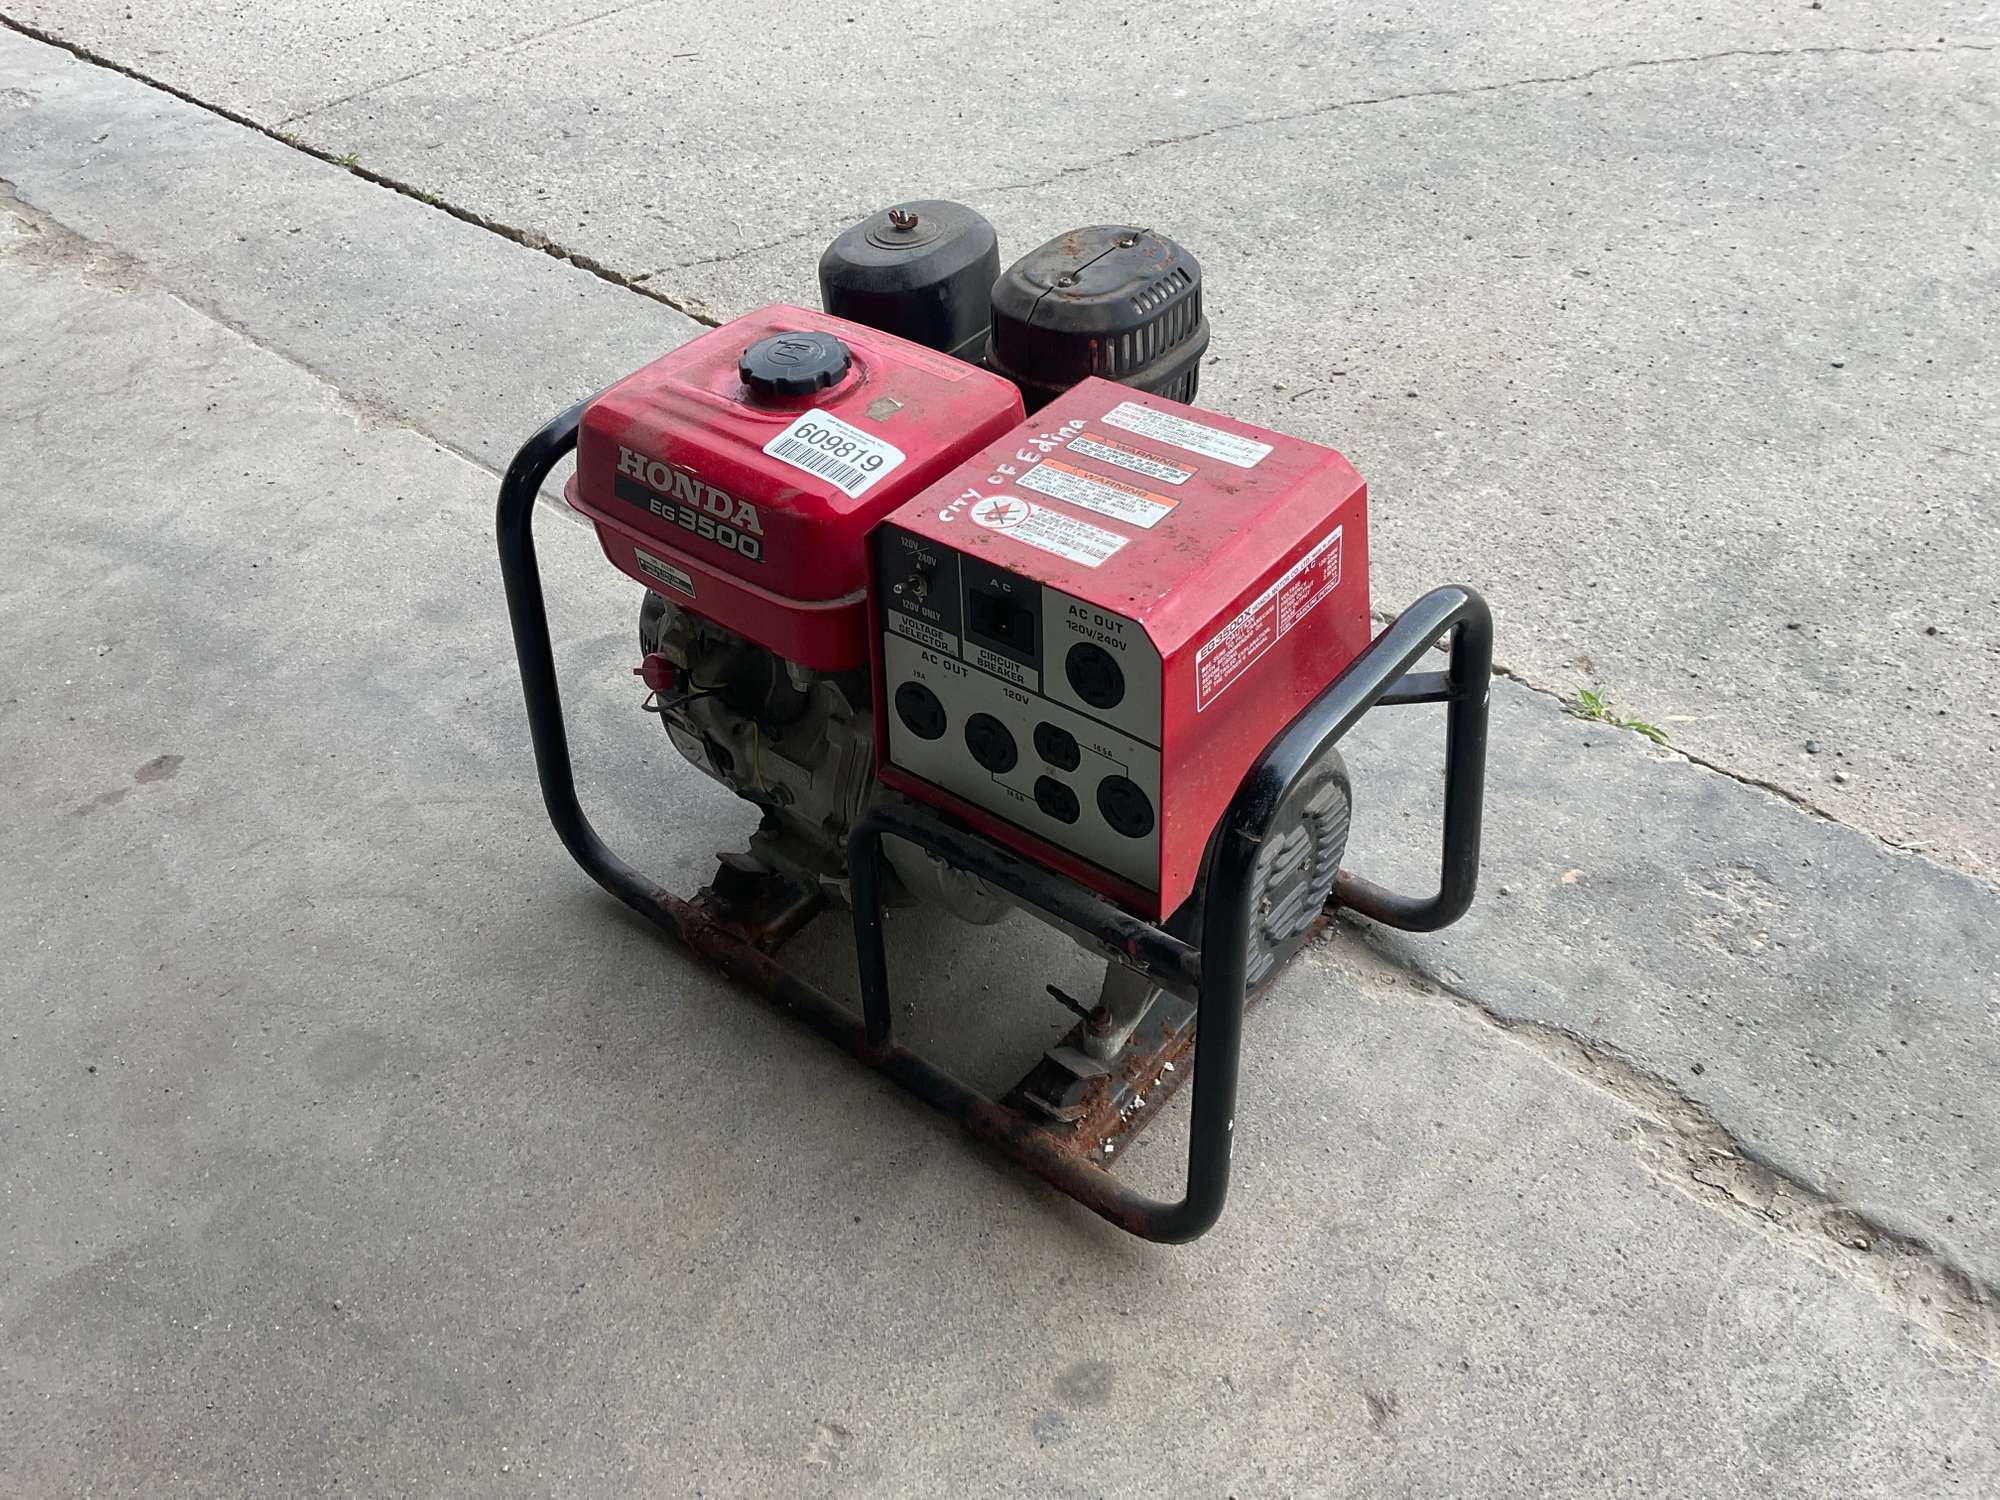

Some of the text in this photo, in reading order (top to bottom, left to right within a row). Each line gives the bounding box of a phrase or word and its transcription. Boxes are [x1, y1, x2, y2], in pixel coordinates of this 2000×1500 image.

[794, 422, 884, 472] 609819
[1116, 443, 1181, 468] WARNING
[617, 446, 764, 536] HONDA
[1083, 472, 1150, 497] WARNING
[900, 536, 919, 550] 120V
[917, 552, 937, 567] 240V
[902, 598, 941, 622] 120V ONLY
[1069, 605, 1124, 633] AC OUT
[898, 623, 949, 651] SELECTOR
[901, 615, 945, 640] VOLTAGE
[1066, 620, 1127, 651] 120V/240V
[1200, 611, 1251, 658] EG3500X
[921, 650, 969, 678] AC OUT
[976, 657, 1025, 685] BREAKER
[979, 649, 1021, 673] CIRCUIT
[1002, 687, 1029, 705] 120V
